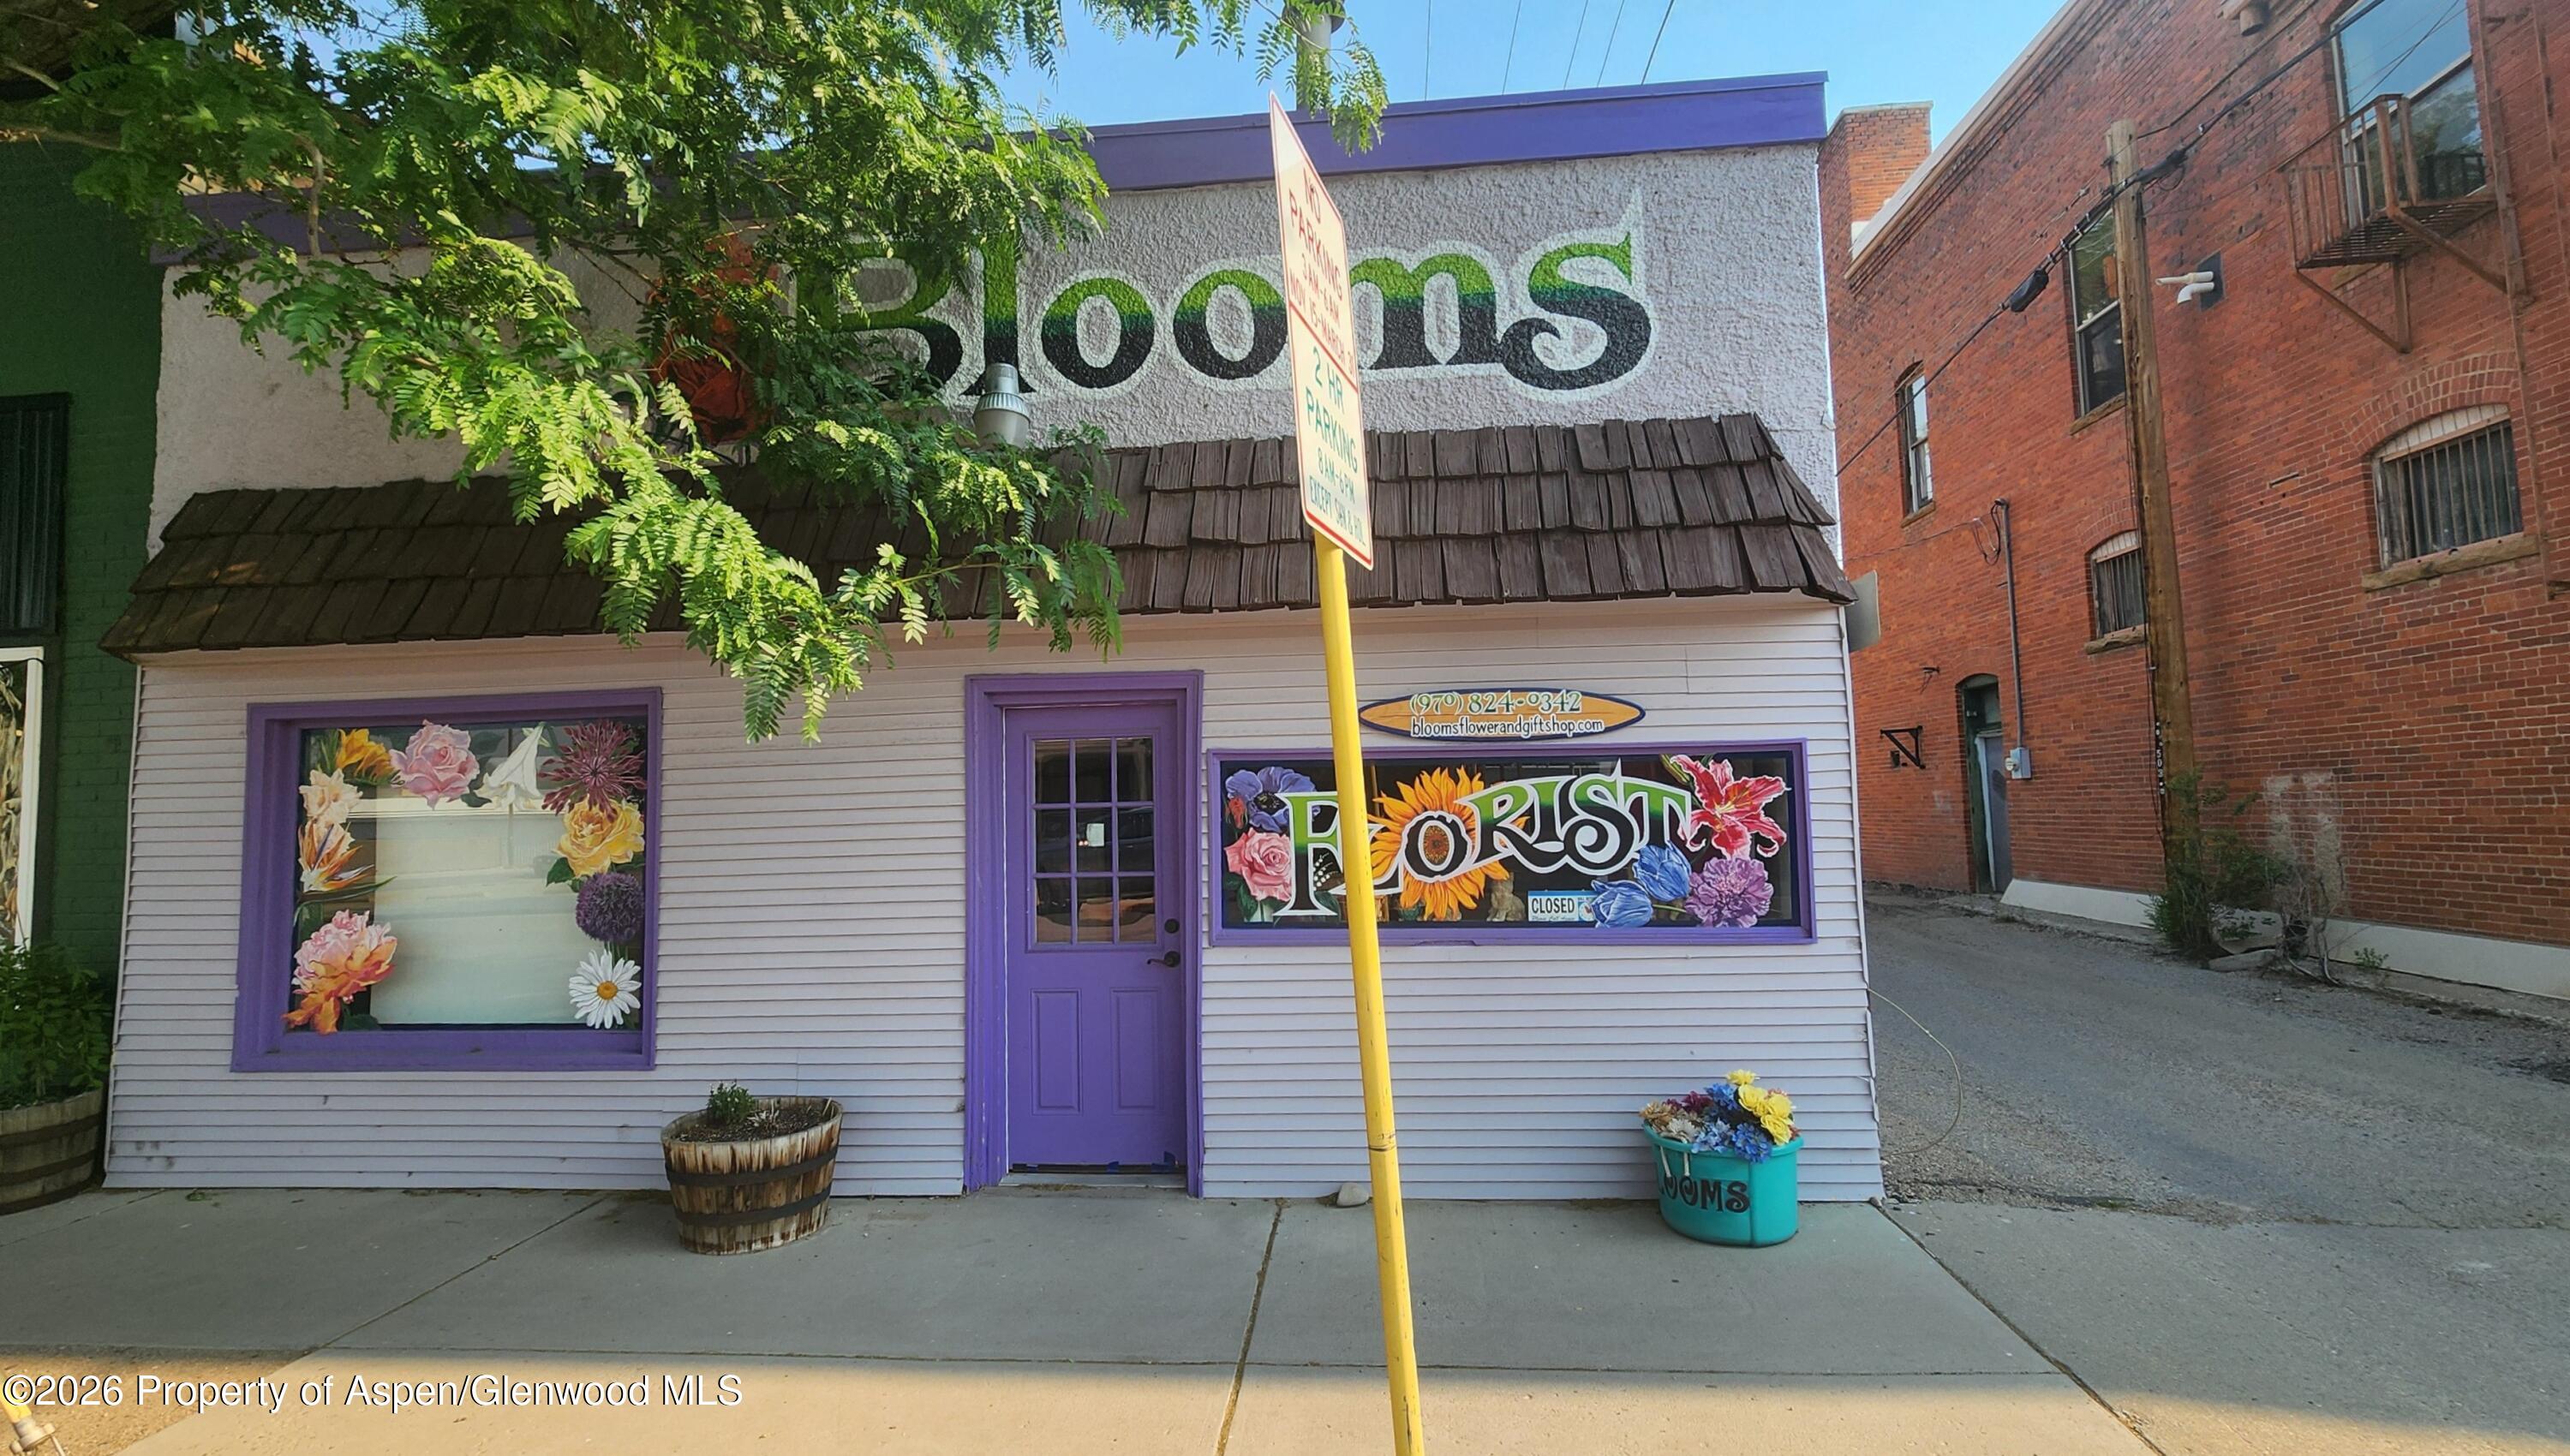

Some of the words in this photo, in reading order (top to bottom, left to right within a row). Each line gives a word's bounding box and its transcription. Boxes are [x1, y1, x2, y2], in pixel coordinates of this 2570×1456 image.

[1303, 167, 1321, 224] NO
[1288, 188, 1343, 301] PARKING
[788, 201, 1655, 398] Blooms
[1289, 267, 1306, 313] NOV
[1313, 345, 1323, 388] 2
[1327, 362, 1345, 415] HR
[1306, 386, 1359, 474] PARKING
[1309, 474, 1333, 519] EXCEPT
[1409, 691, 1464, 715] (970)
[1467, 689, 1583, 714] 824-0342
[1411, 715, 1605, 739] bloomsflowerandgiftshop.com
[1272, 758, 1693, 916] FORIST
[1531, 897, 1575, 914] CLOSED
[1659, 1175, 1751, 1214] OOMS
